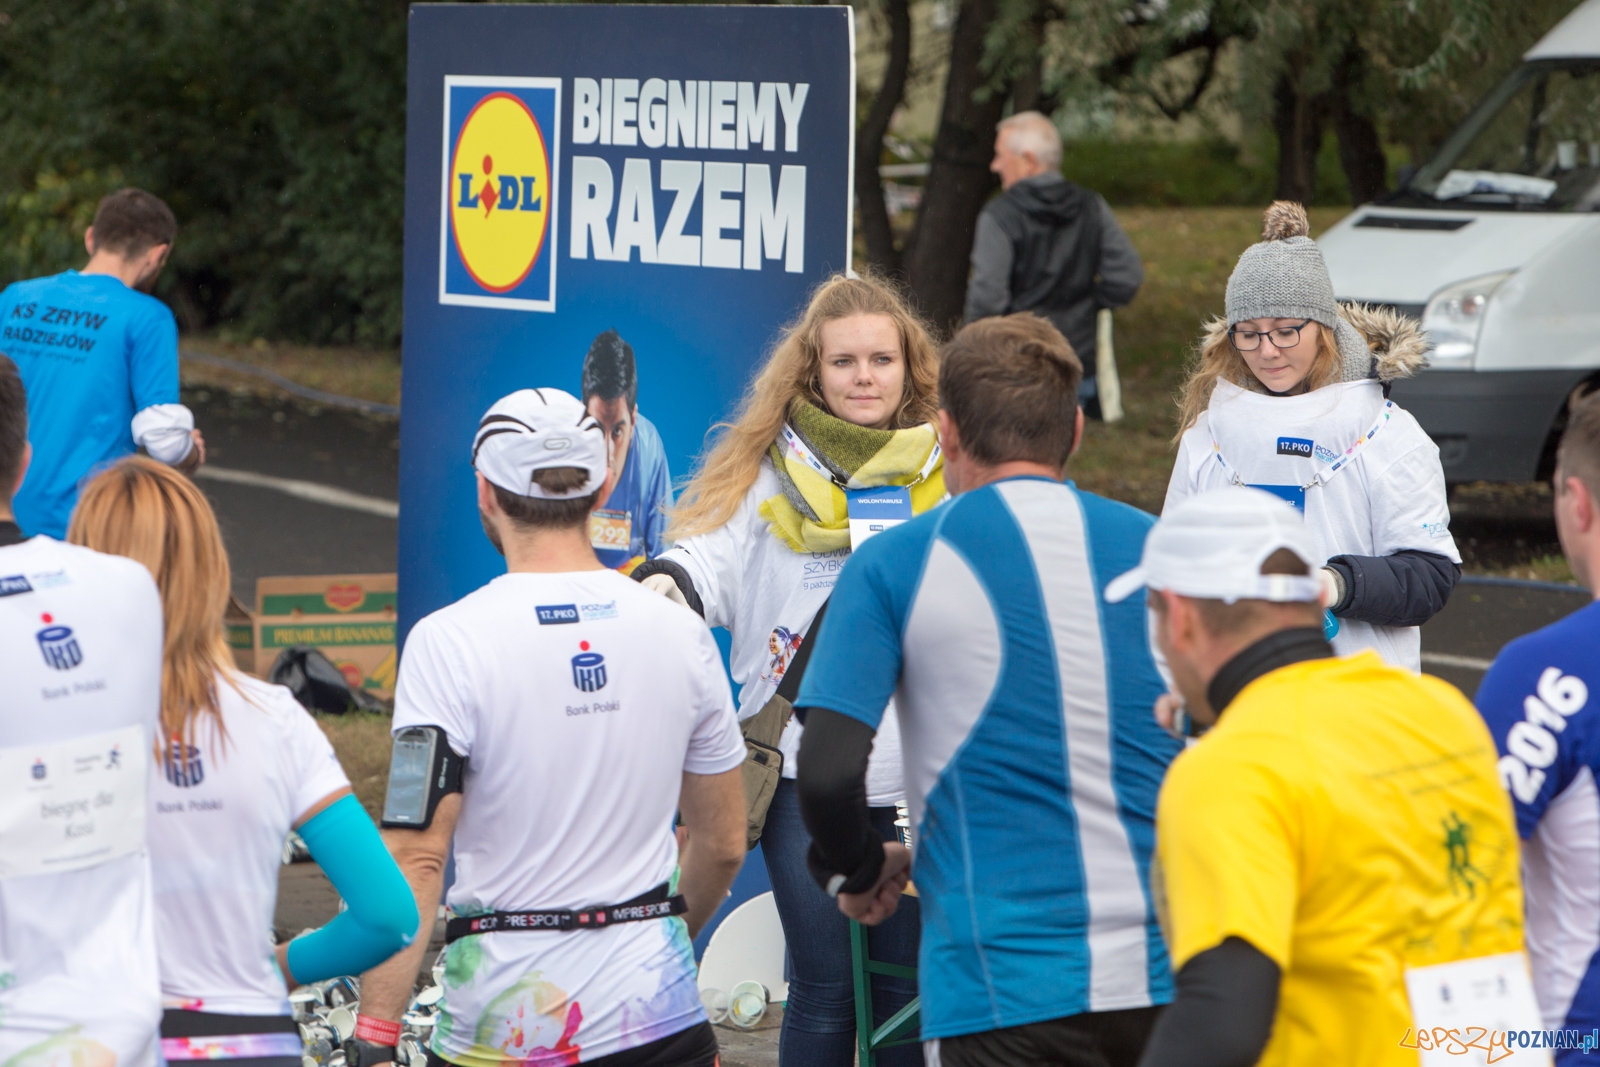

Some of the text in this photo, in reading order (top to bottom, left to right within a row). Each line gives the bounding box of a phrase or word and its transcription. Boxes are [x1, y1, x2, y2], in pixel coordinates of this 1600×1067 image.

[573, 77, 810, 153] BIEGNIEMY
[569, 156, 807, 274] RAZEM
[41, 306, 108, 331] ZRYW
[3, 326, 96, 352] RADZIEJÓW
[592, 524, 627, 544] 292
[273, 625, 395, 645] PREMIUM BANANAS
[566, 700, 620, 717] Bank Polski
[1496, 666, 1589, 805] 2016
